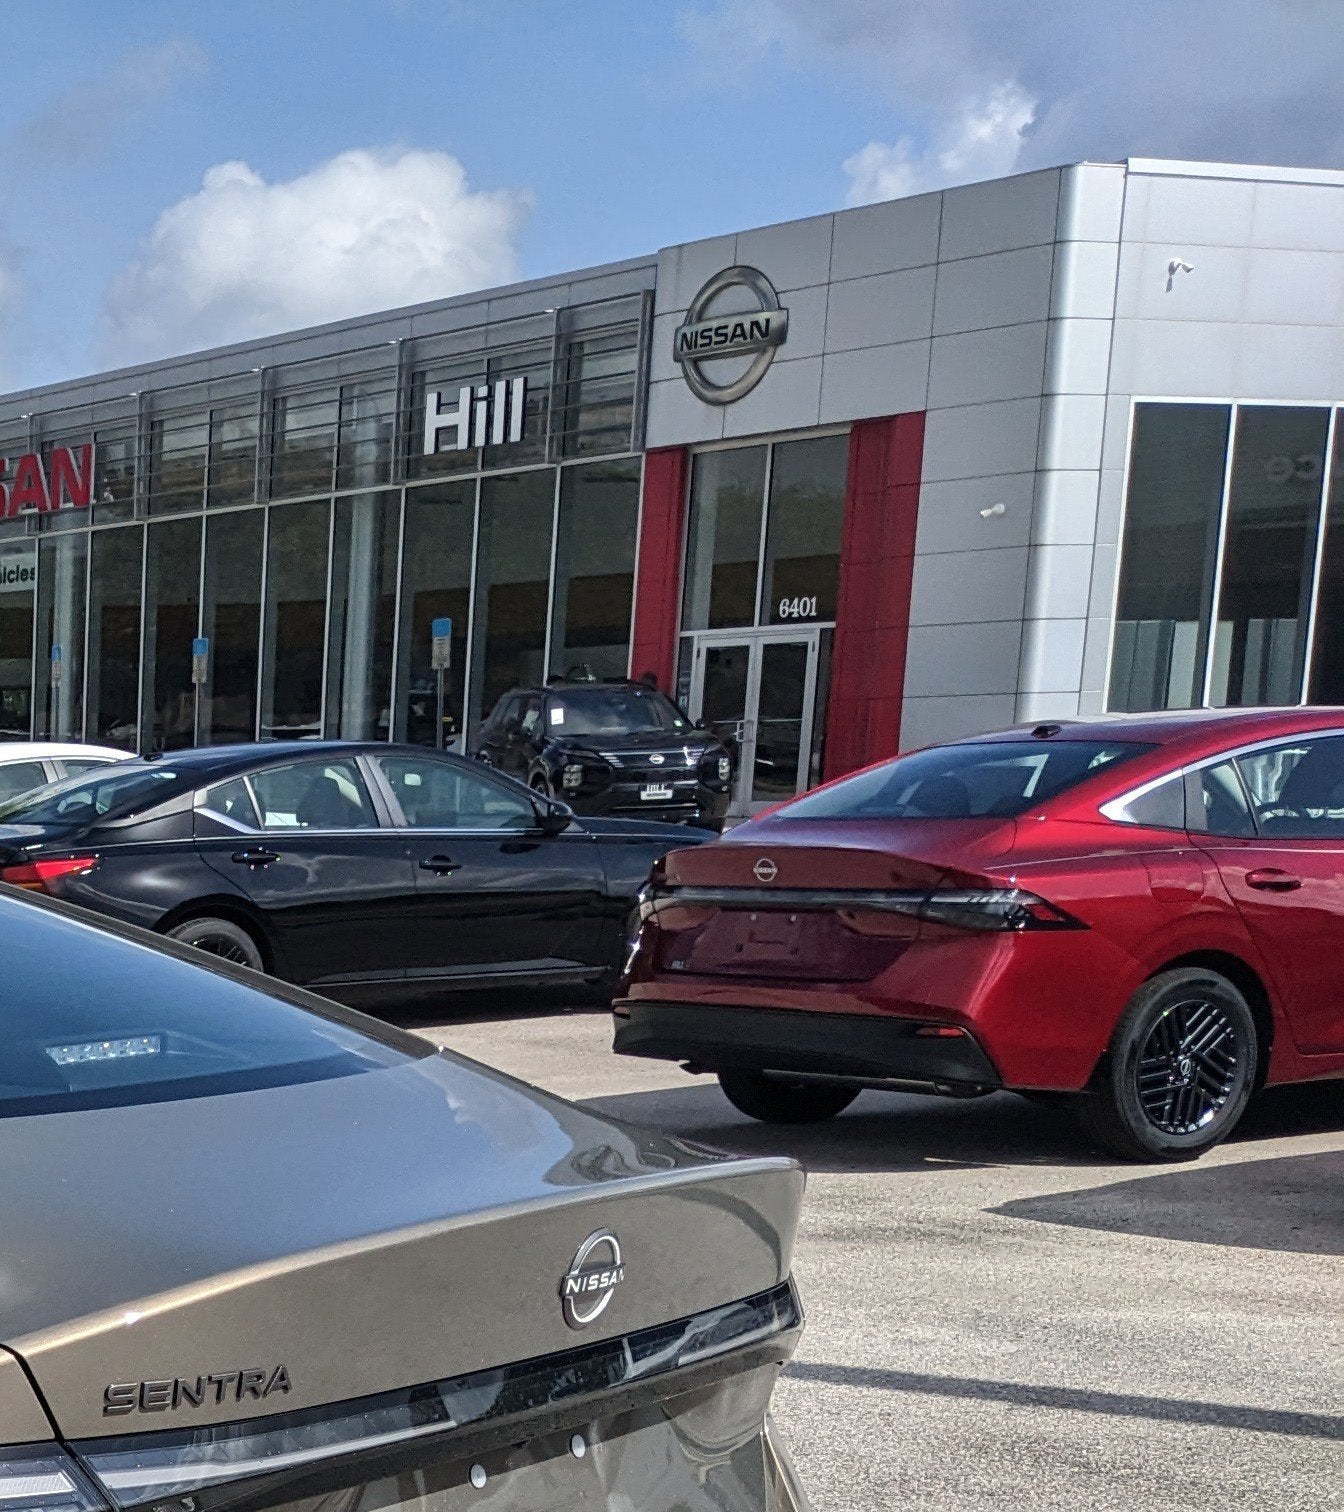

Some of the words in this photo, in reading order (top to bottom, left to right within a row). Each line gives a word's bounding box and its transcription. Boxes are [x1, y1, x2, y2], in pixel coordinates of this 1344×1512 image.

[679, 318, 771, 351] NISSAN
[424, 376, 526, 455] Hill
[779, 596, 817, 618] 6401
[565, 1269, 625, 1294] NISSAN
[102, 1363, 293, 1417] SENTRA
